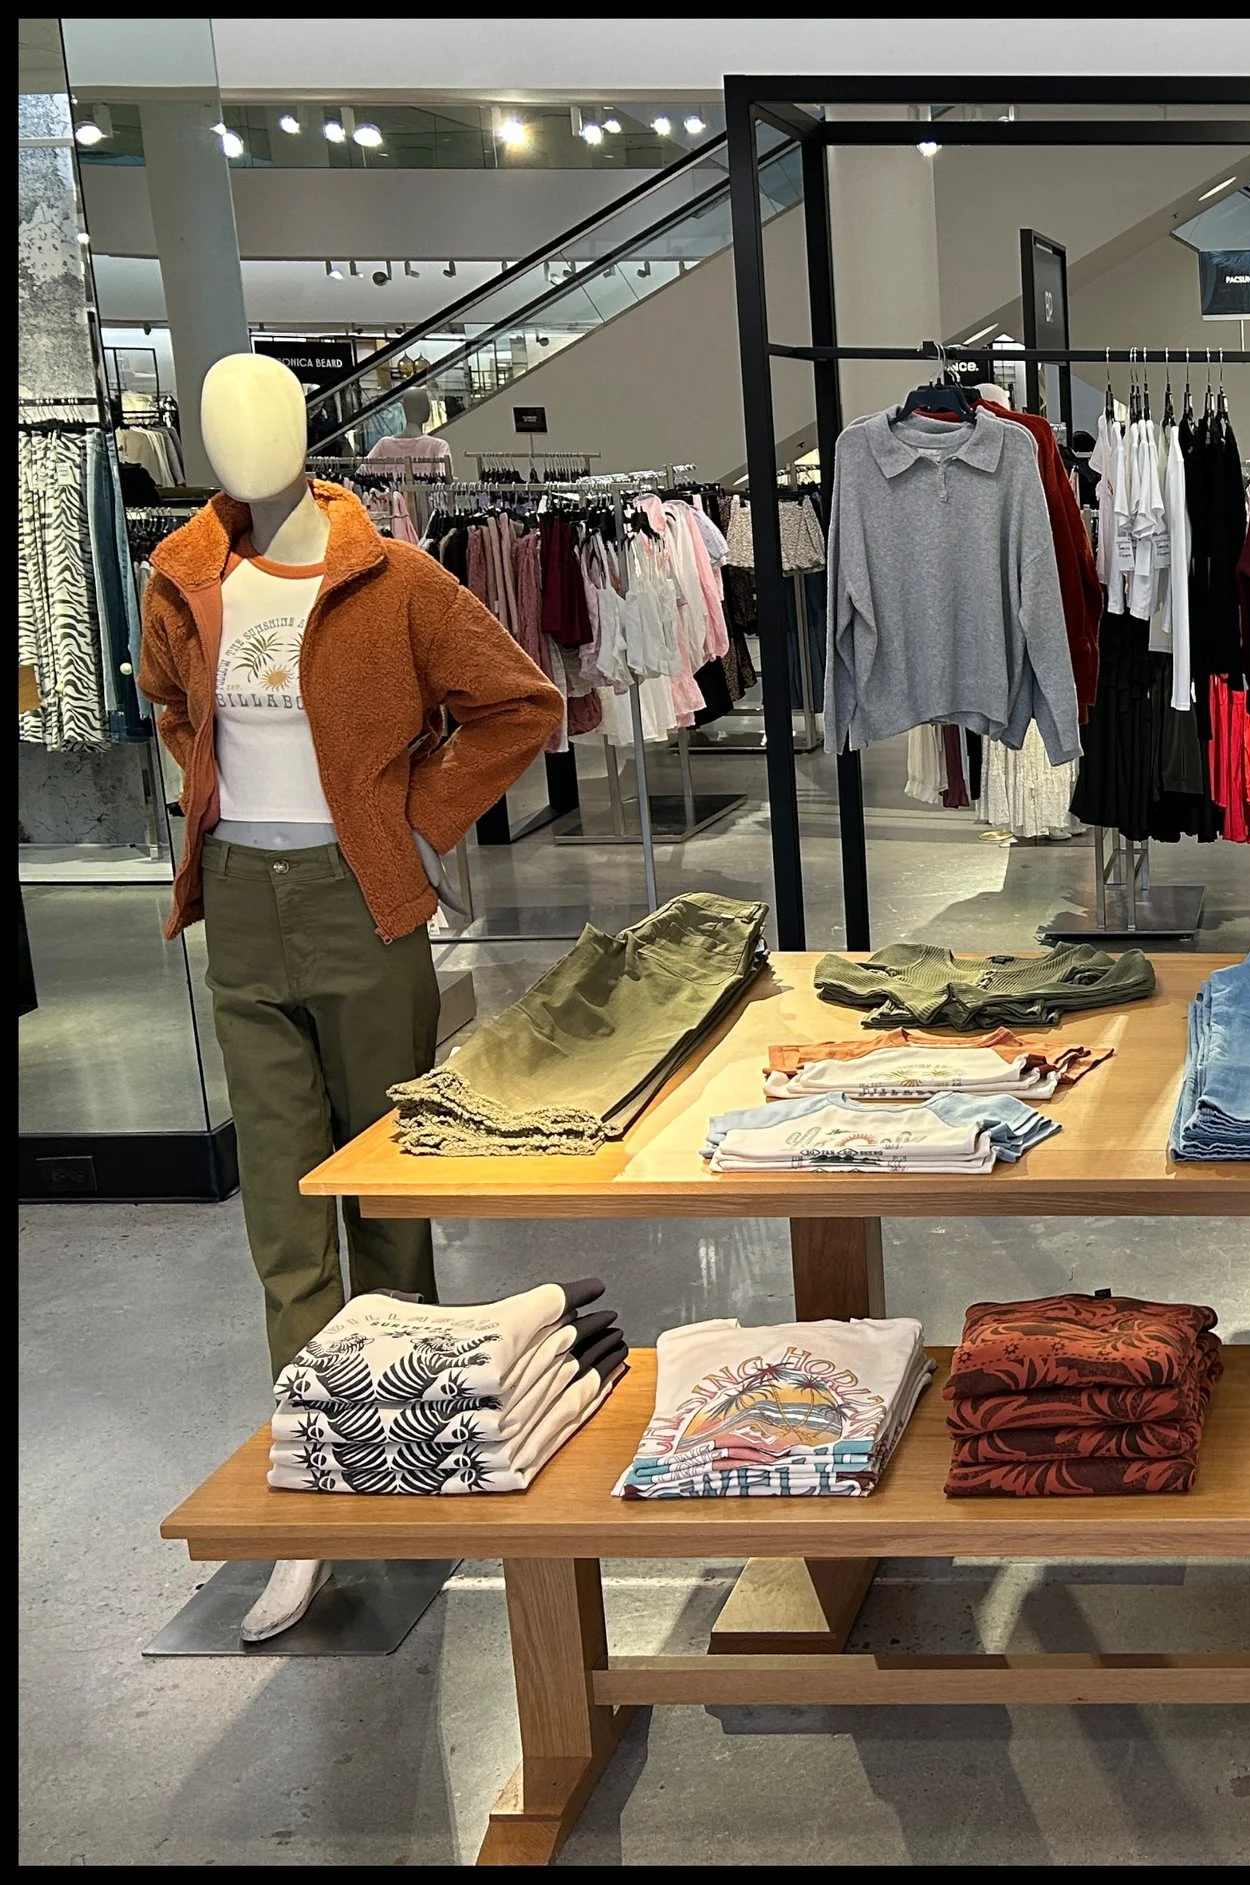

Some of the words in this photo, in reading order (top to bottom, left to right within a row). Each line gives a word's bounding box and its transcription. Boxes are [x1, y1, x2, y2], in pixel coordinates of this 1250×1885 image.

[316, 359, 343, 368] BEARD
[224, 638, 245, 657] THE
[243, 617, 295, 641] SUNSHINE
